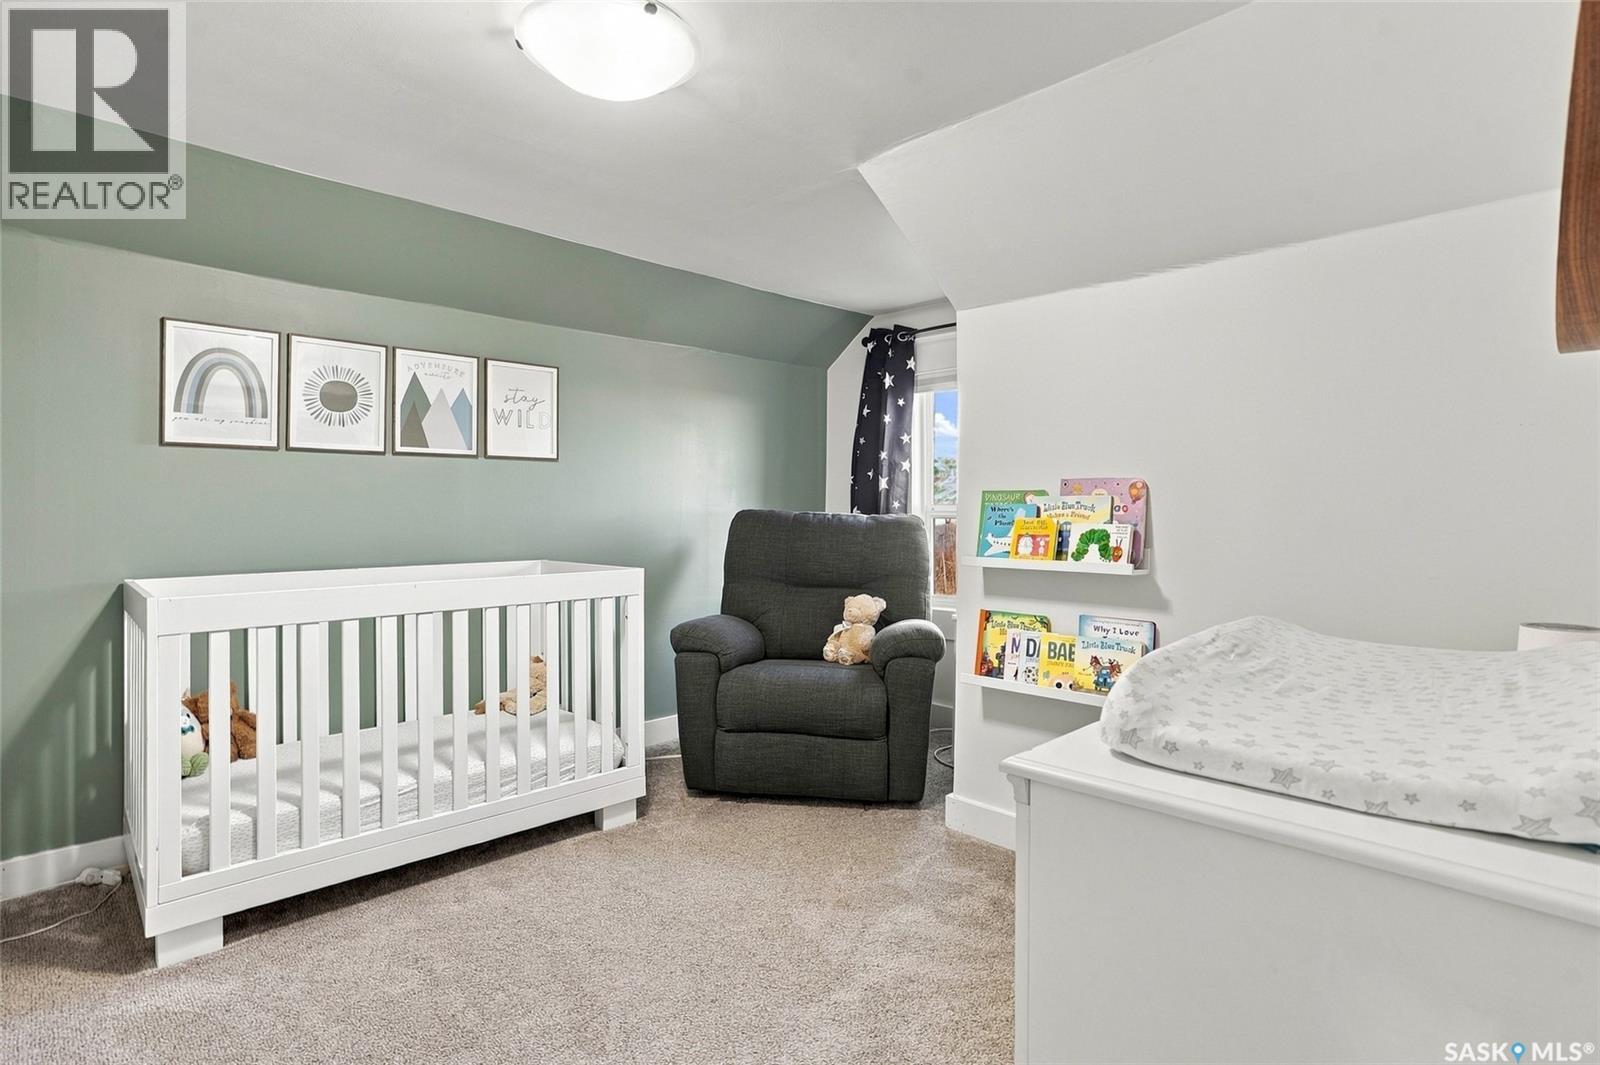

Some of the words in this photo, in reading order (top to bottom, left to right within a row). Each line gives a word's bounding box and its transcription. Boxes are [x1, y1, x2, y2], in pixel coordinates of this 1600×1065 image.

[407, 361, 467, 378] ADVENTURE
[503, 387, 546, 411] stay
[492, 408, 553, 430] WILD
[984, 493, 1021, 502] DINOSAUR
[1043, 503, 1060, 513] Little
[1061, 501, 1075, 511] Blue
[1075, 501, 1096, 513] Truck
[1093, 624, 1110, 635] Why
[1119, 628, 1140, 637] Love
[1081, 640, 1099, 650] Little
[1100, 641, 1115, 651] Blue
[1115, 642, 1137, 655] Truck
